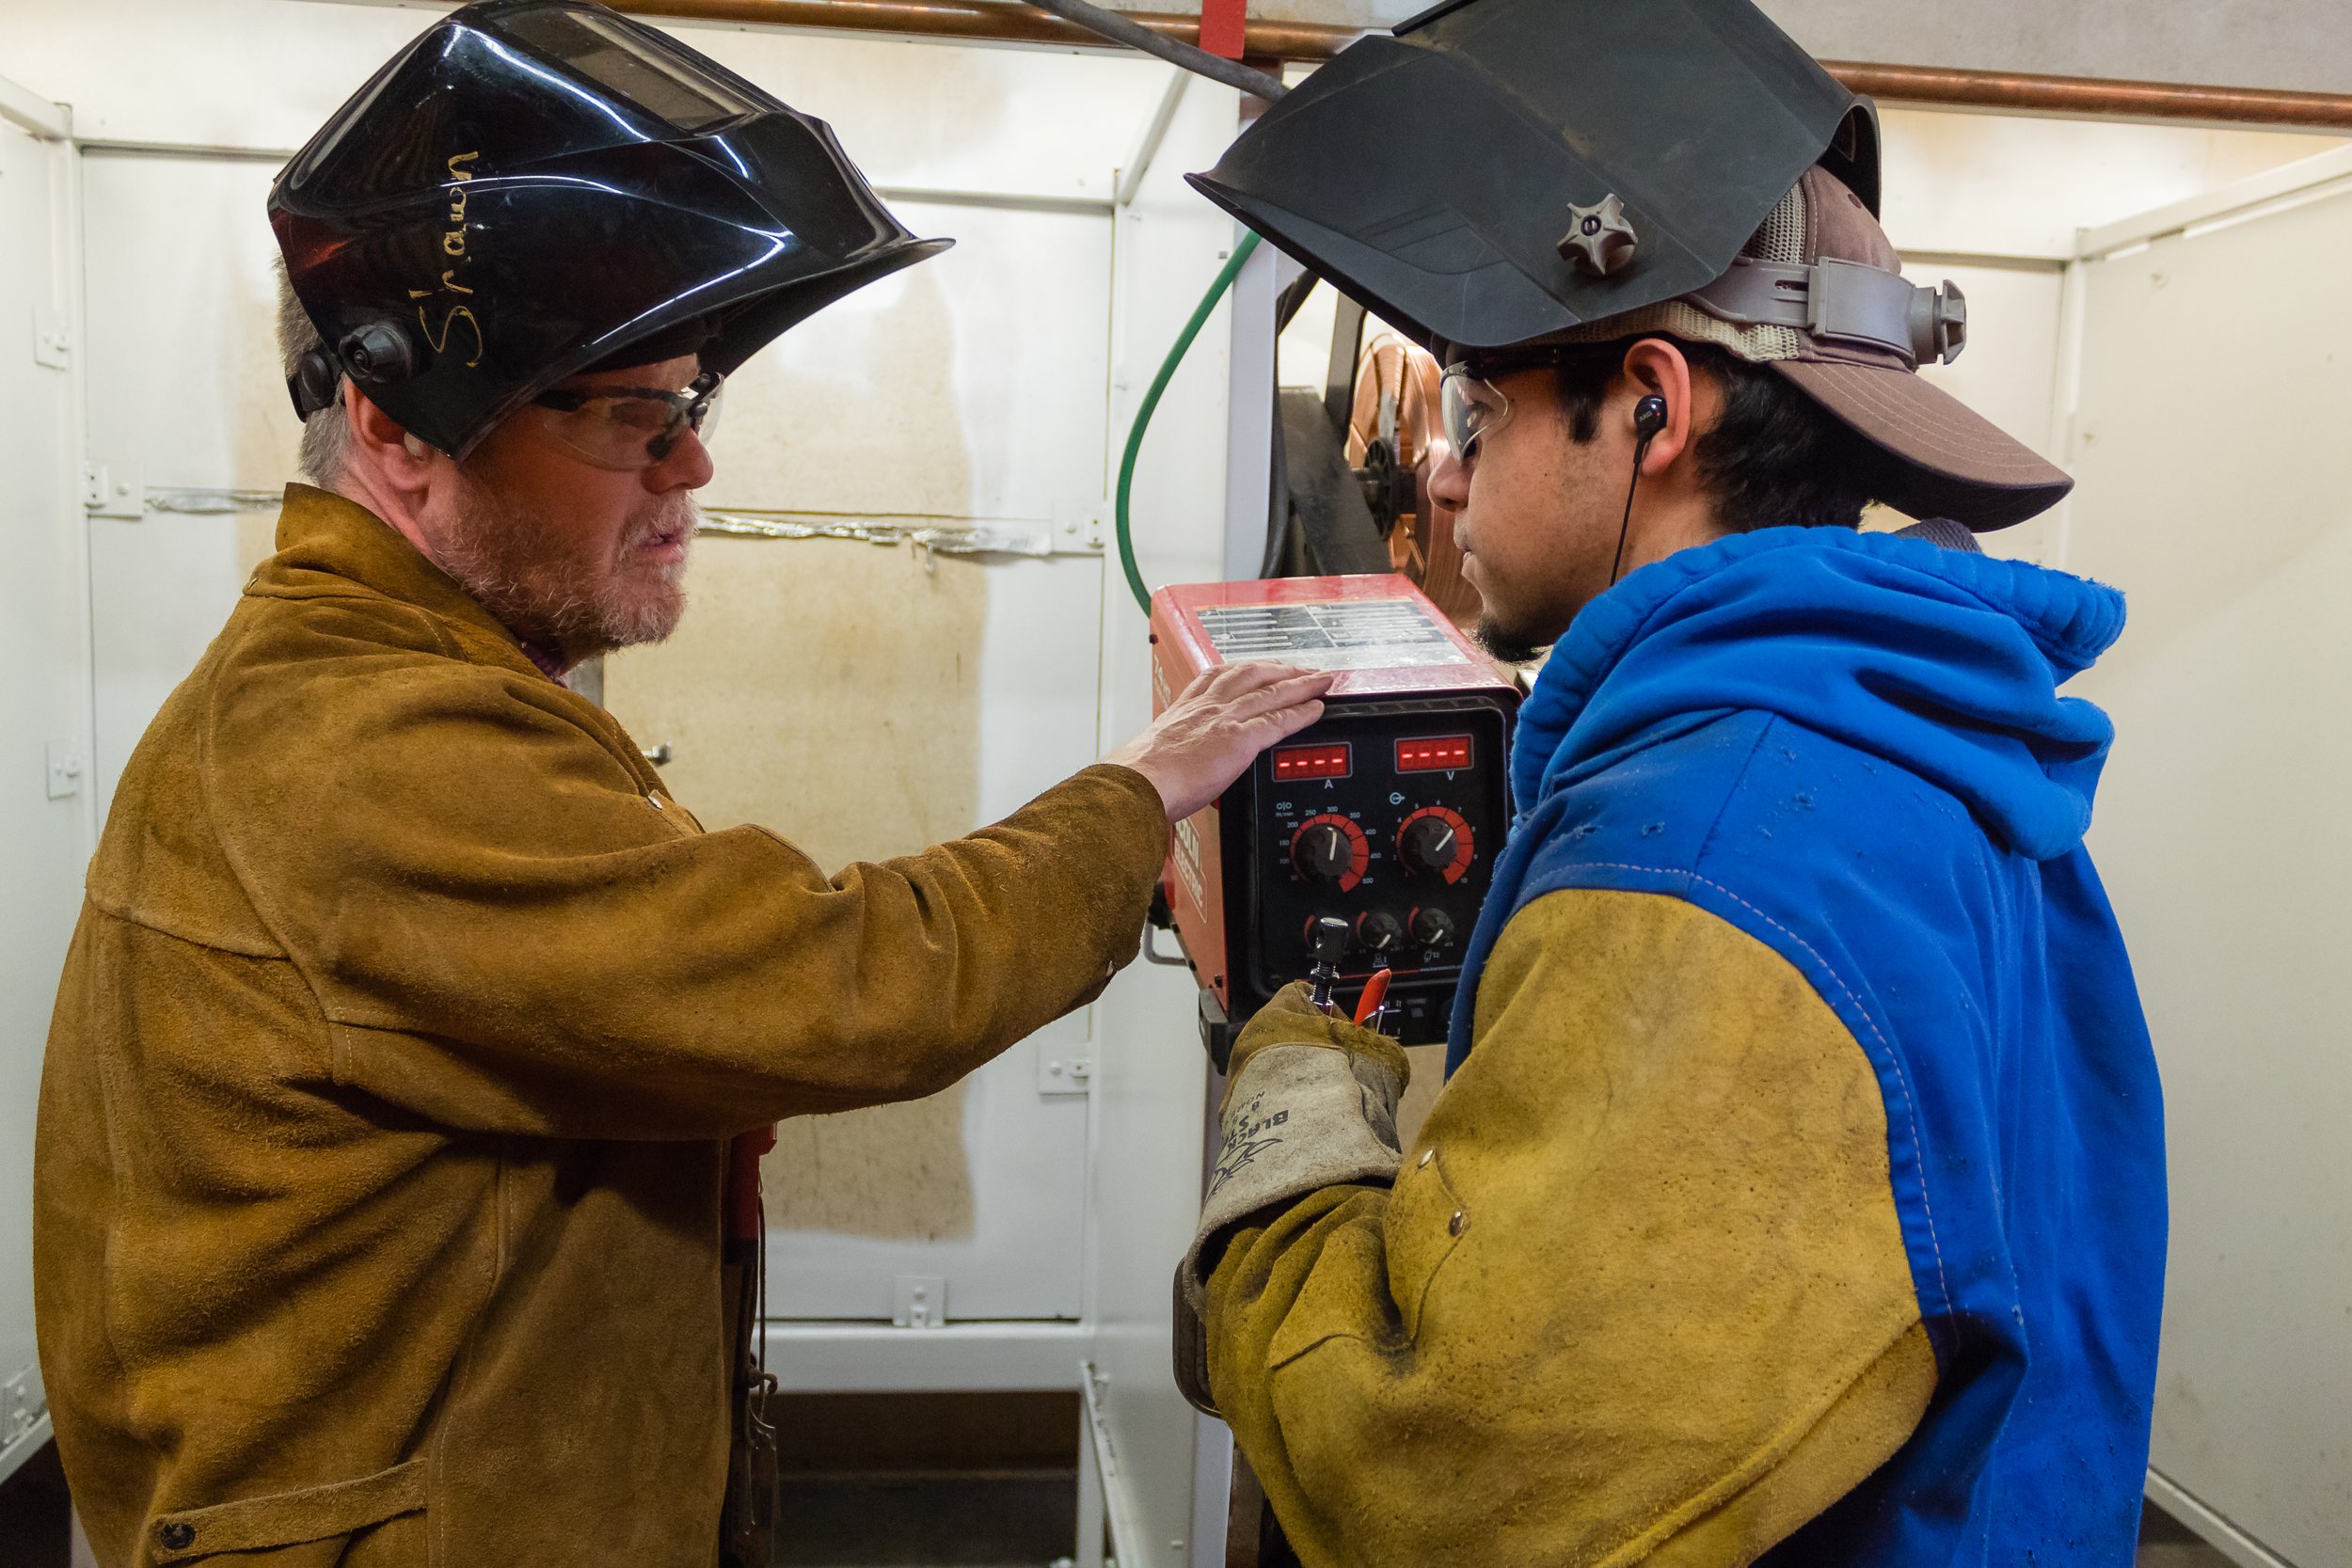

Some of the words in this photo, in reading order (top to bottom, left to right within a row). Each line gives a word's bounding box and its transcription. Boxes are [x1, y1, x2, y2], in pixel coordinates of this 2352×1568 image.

[1324, 779, 1334, 789] A
[1446, 770, 1455, 781] V
[1174, 837, 1203, 909] ELECTRIC
[1227, 1110, 1289, 1155] BLACK
